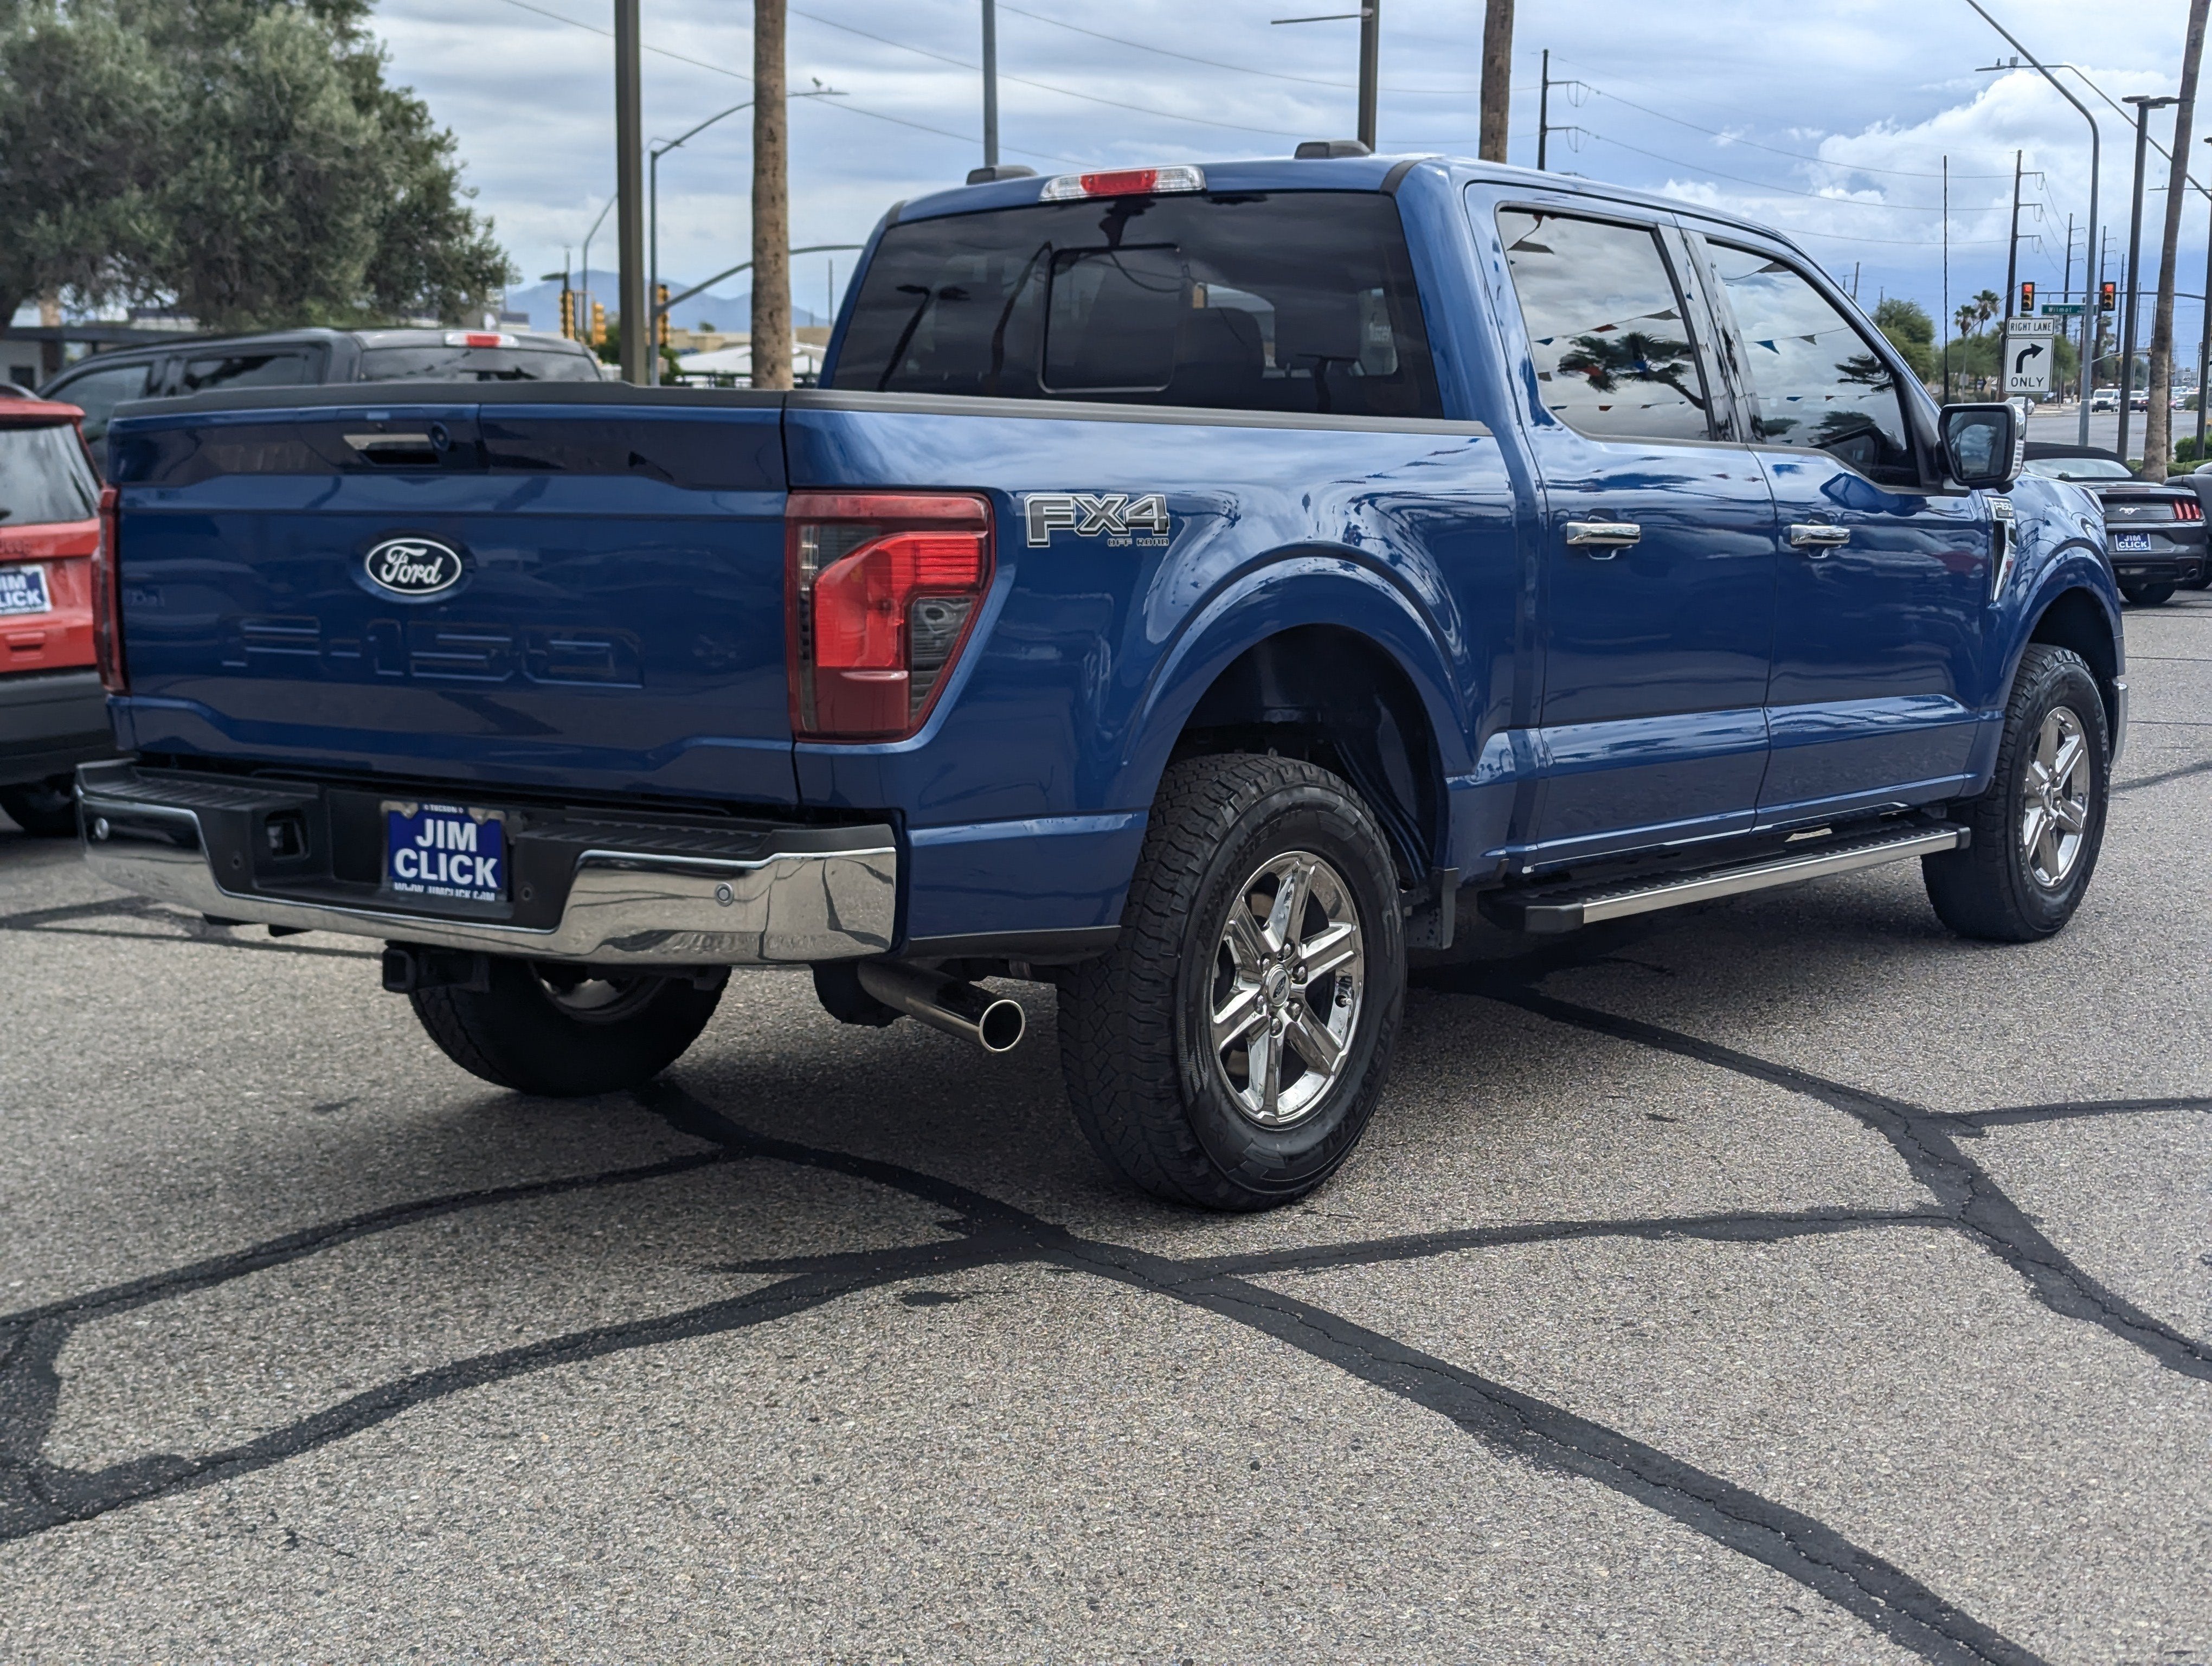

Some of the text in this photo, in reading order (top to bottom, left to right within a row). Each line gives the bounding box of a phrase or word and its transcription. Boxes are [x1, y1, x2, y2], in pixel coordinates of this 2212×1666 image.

[2010, 321, 2052, 332] RIGHT LANE
[2010, 376, 2044, 387] ONLY
[1024, 494, 1171, 548] FX4
[1107, 537, 1169, 547] OFF ROAD
[381, 545, 443, 584] Ford
[0, 574, 27, 591] IM
[415, 818, 477, 853] JIM
[394, 848, 498, 888] CLICK
